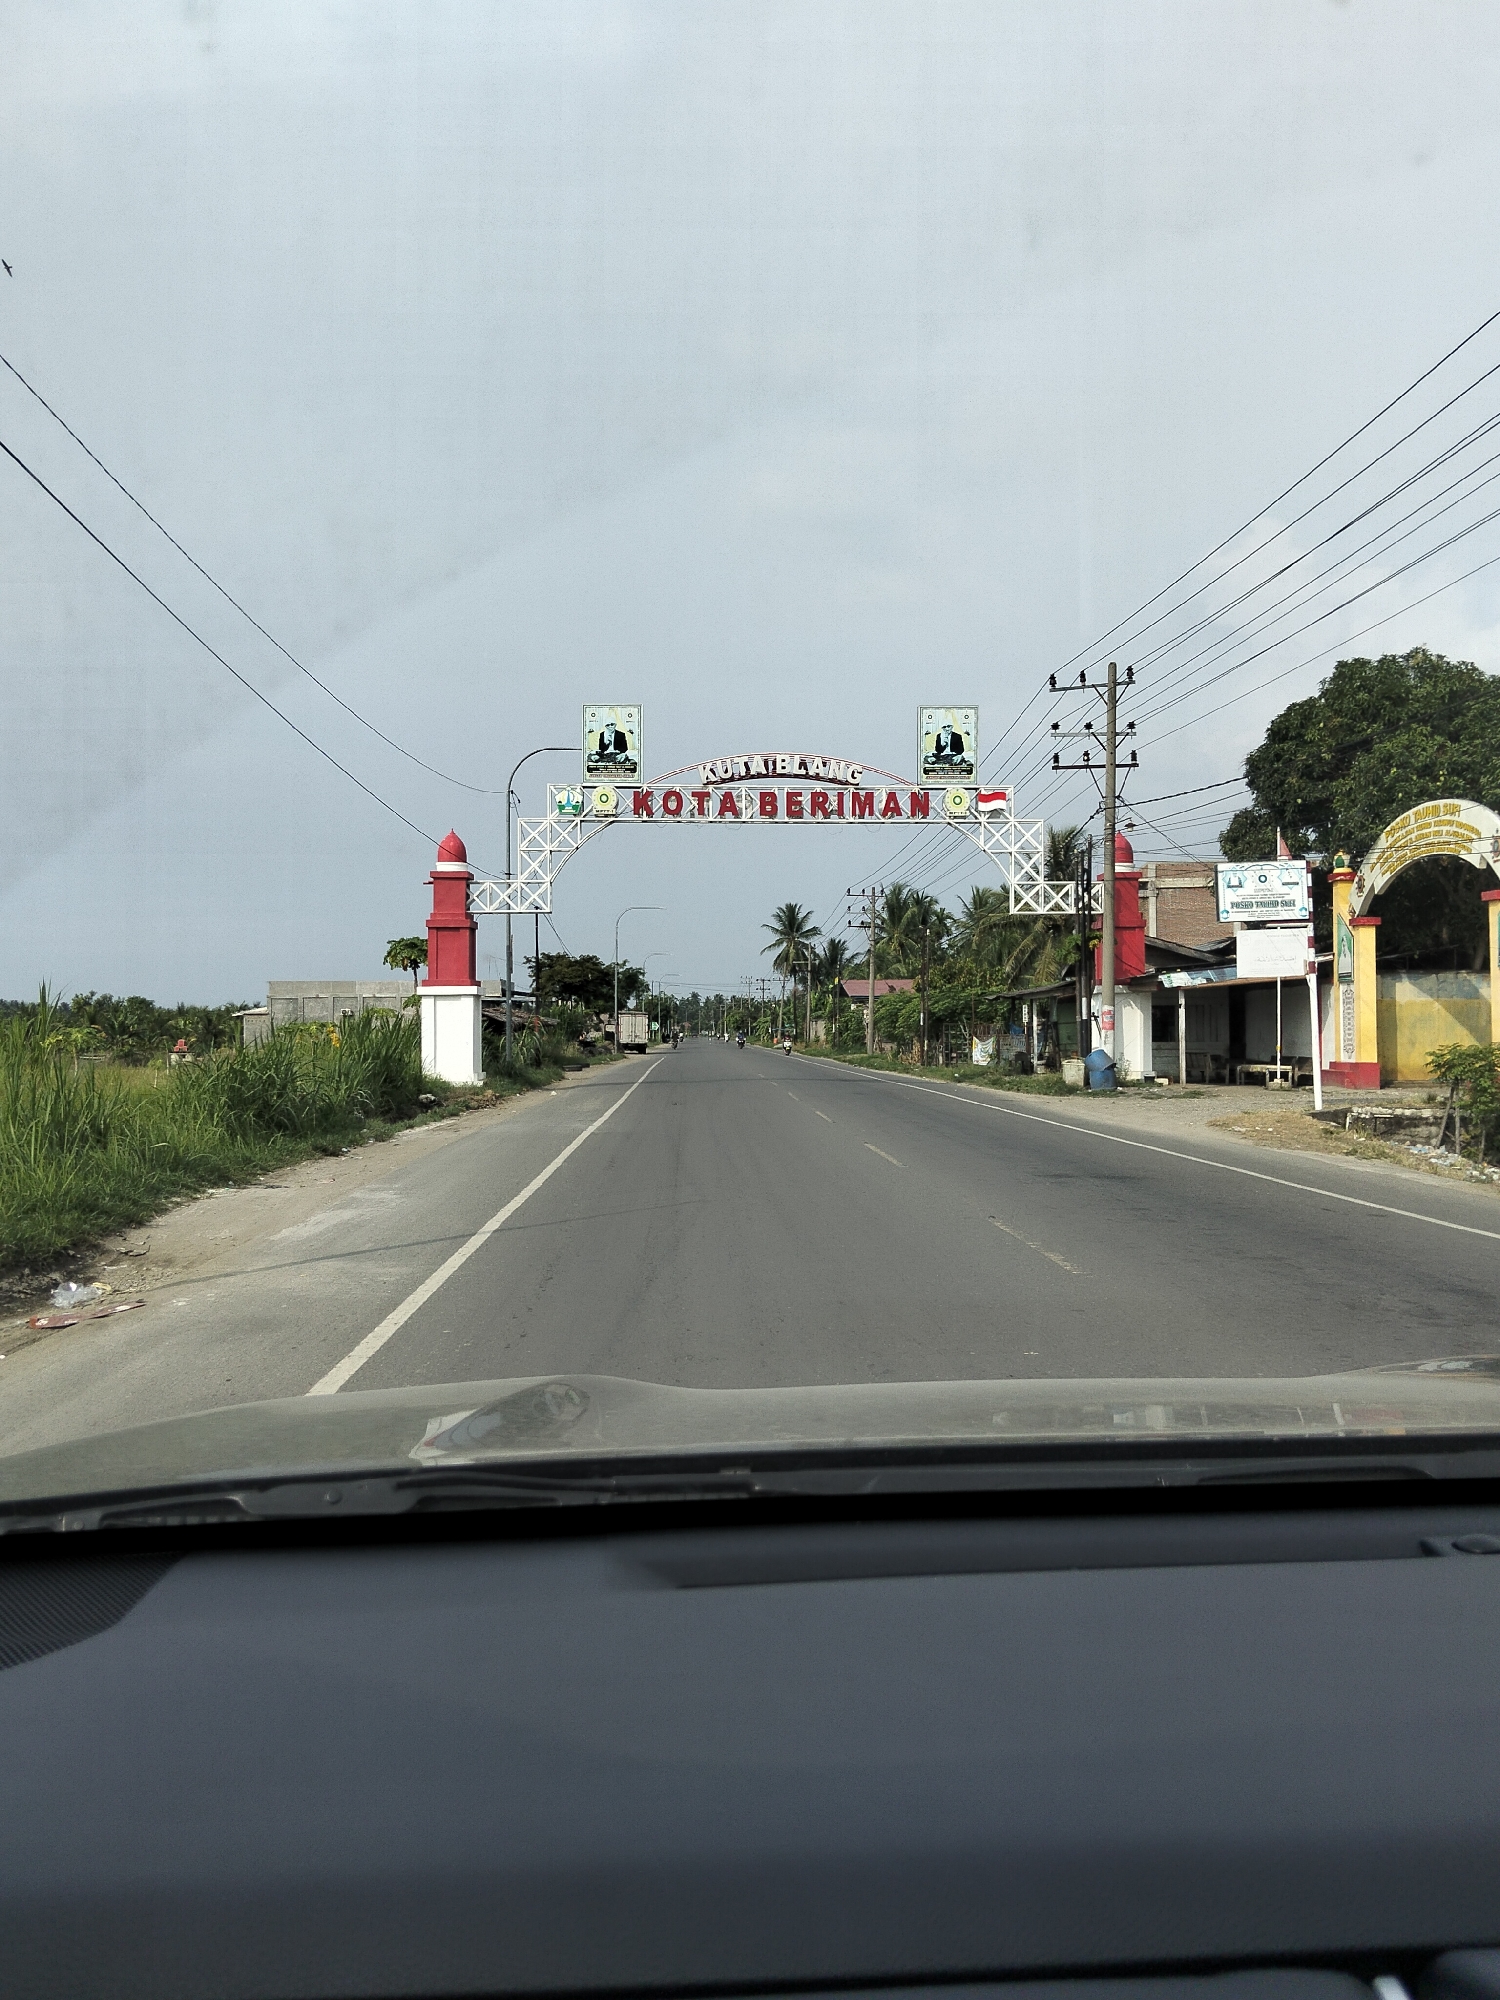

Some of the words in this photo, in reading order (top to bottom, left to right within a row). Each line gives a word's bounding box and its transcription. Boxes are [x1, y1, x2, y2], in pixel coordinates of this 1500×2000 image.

[698, 755, 767, 784] KUTA
[776, 755, 863, 784] BLANG
[633, 790, 739, 816] KOTA
[759, 791, 930, 817] BERIMAN
[1384, 814, 1410, 843] POSKO
[1412, 804, 1441, 822] TAUHID
[1442, 802, 1461, 818] SUFI
